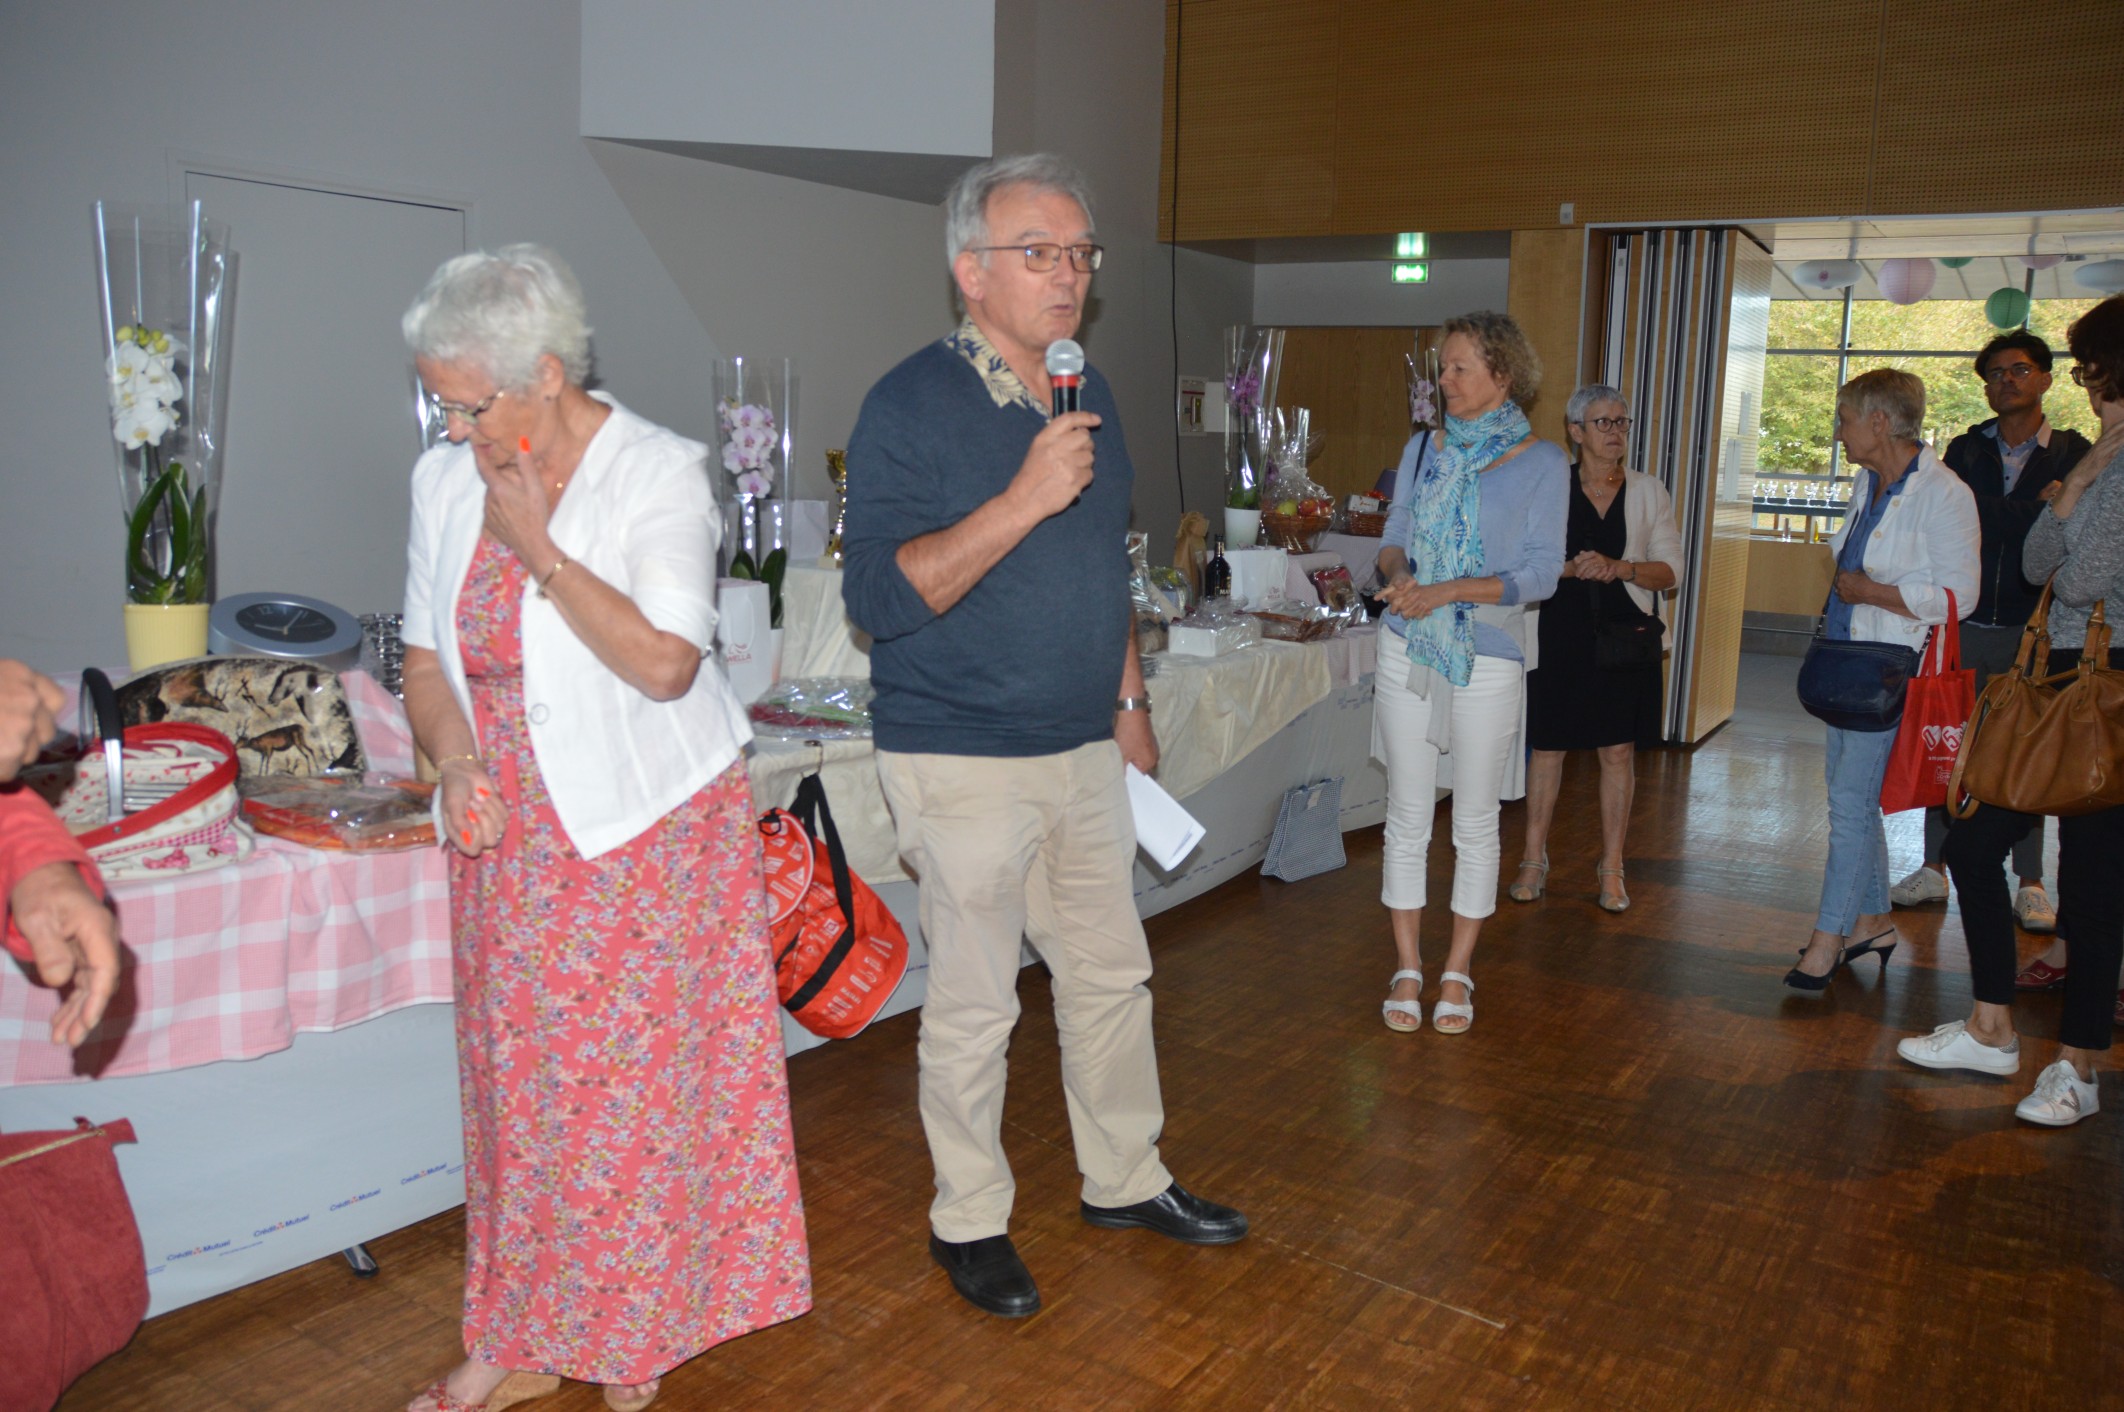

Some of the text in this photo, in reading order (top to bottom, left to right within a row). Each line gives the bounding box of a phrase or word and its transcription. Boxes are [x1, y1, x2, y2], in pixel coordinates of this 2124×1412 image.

[285, 1214, 309, 1227] Mutuel
[167, 1249, 193, 1261] Crédit
[203, 1239, 231, 1252] Mutuel
